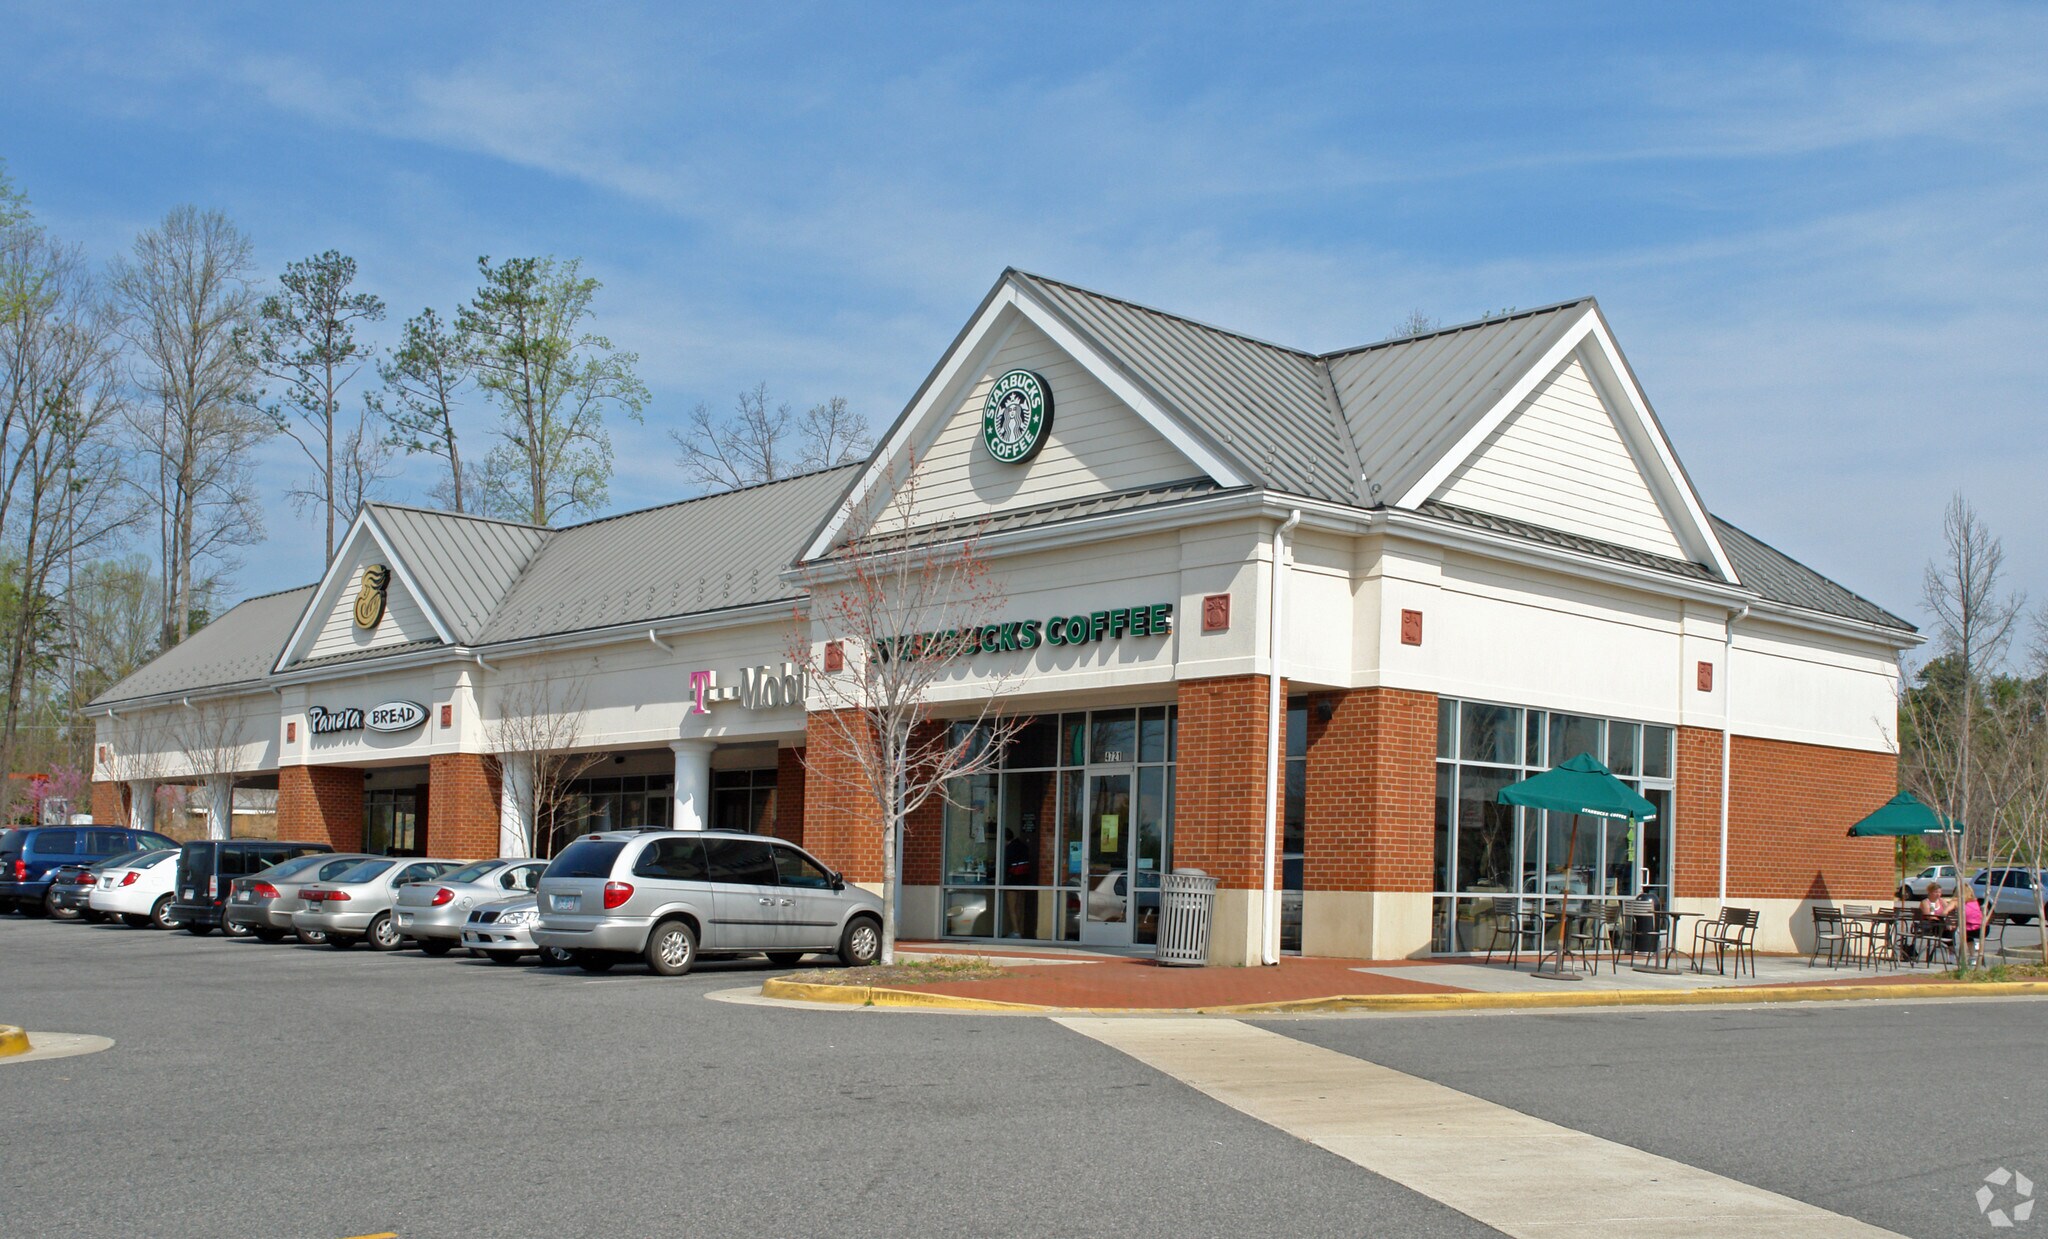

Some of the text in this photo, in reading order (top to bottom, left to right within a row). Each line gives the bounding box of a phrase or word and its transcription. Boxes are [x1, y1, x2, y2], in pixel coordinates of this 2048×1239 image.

[986, 374, 1041, 419] STARBUCKS
[990, 430, 1034, 458] COFFEE
[1045, 603, 1172, 648] COFFEE
[308, 706, 415, 733] Panera BREAD
[1105, 751, 1122, 762] 4721
